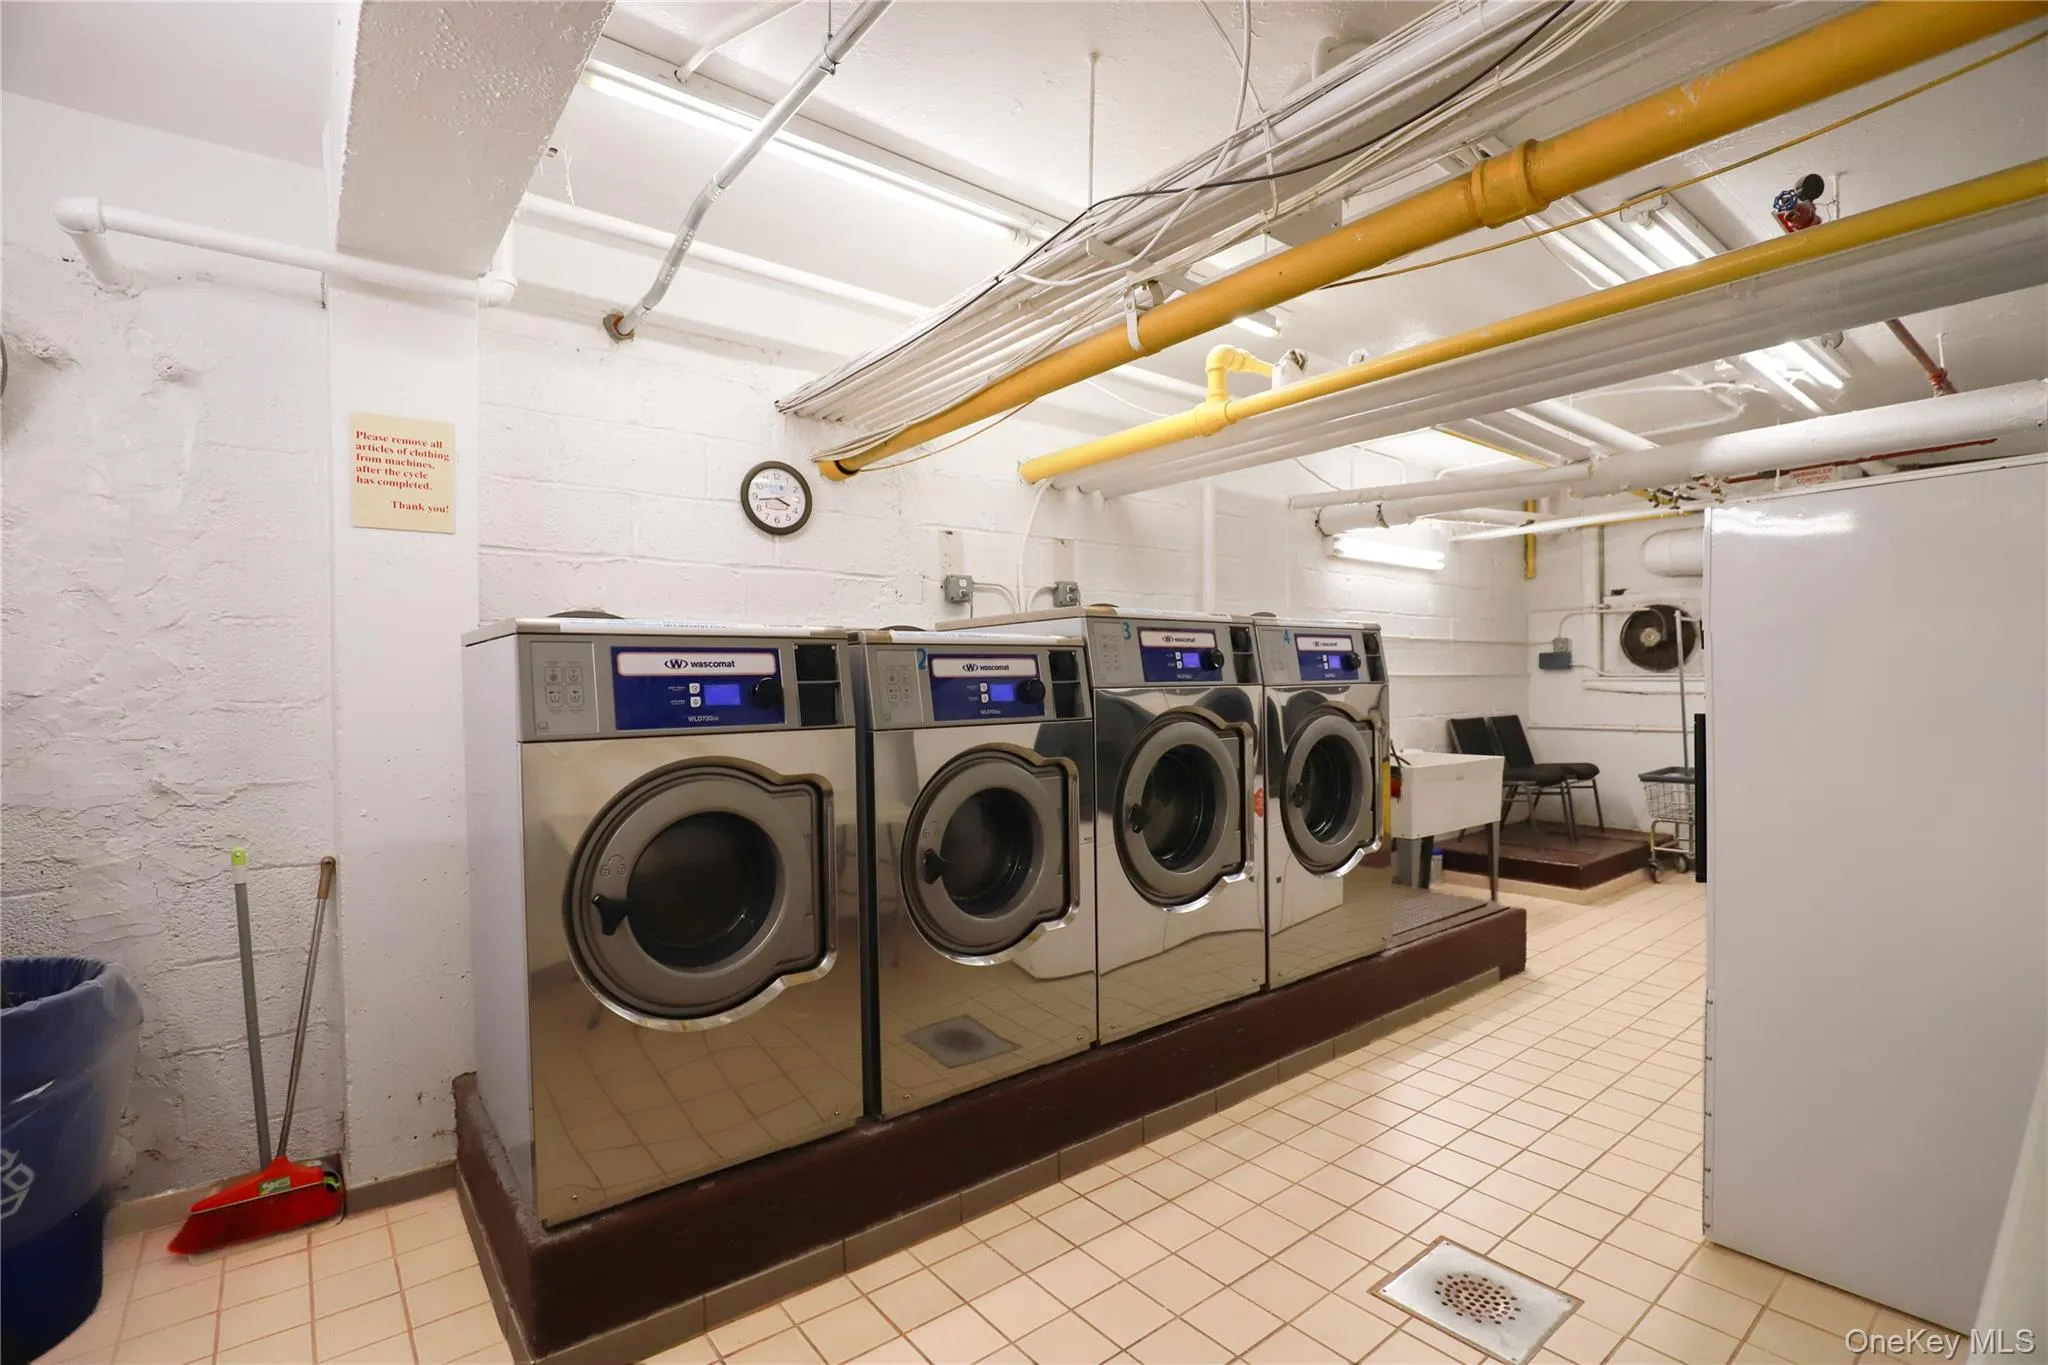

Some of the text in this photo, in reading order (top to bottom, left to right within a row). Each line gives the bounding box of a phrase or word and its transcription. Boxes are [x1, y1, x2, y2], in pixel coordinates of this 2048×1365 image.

[356, 430, 443, 449] Please remove all
[356, 443, 450, 462] articles of clothing
[356, 453, 382, 464] from
[356, 465, 428, 480] after the cycle
[356, 475, 375, 485] has
[755, 482, 763, 491] 10
[792, 486, 799, 494] 2
[752, 491, 759, 500] 9
[392, 500, 449, 514] Thank you!
[756, 504, 763, 512] 8
[764, 512, 770, 521] 7
[774, 516, 781, 525] 6
[785, 513, 792, 522] 5
[1123, 622, 1131, 640] 3
[1283, 628, 1290, 645] 4
[690, 660, 736, 668] wascomat
[917, 648, 926, 670] 2
